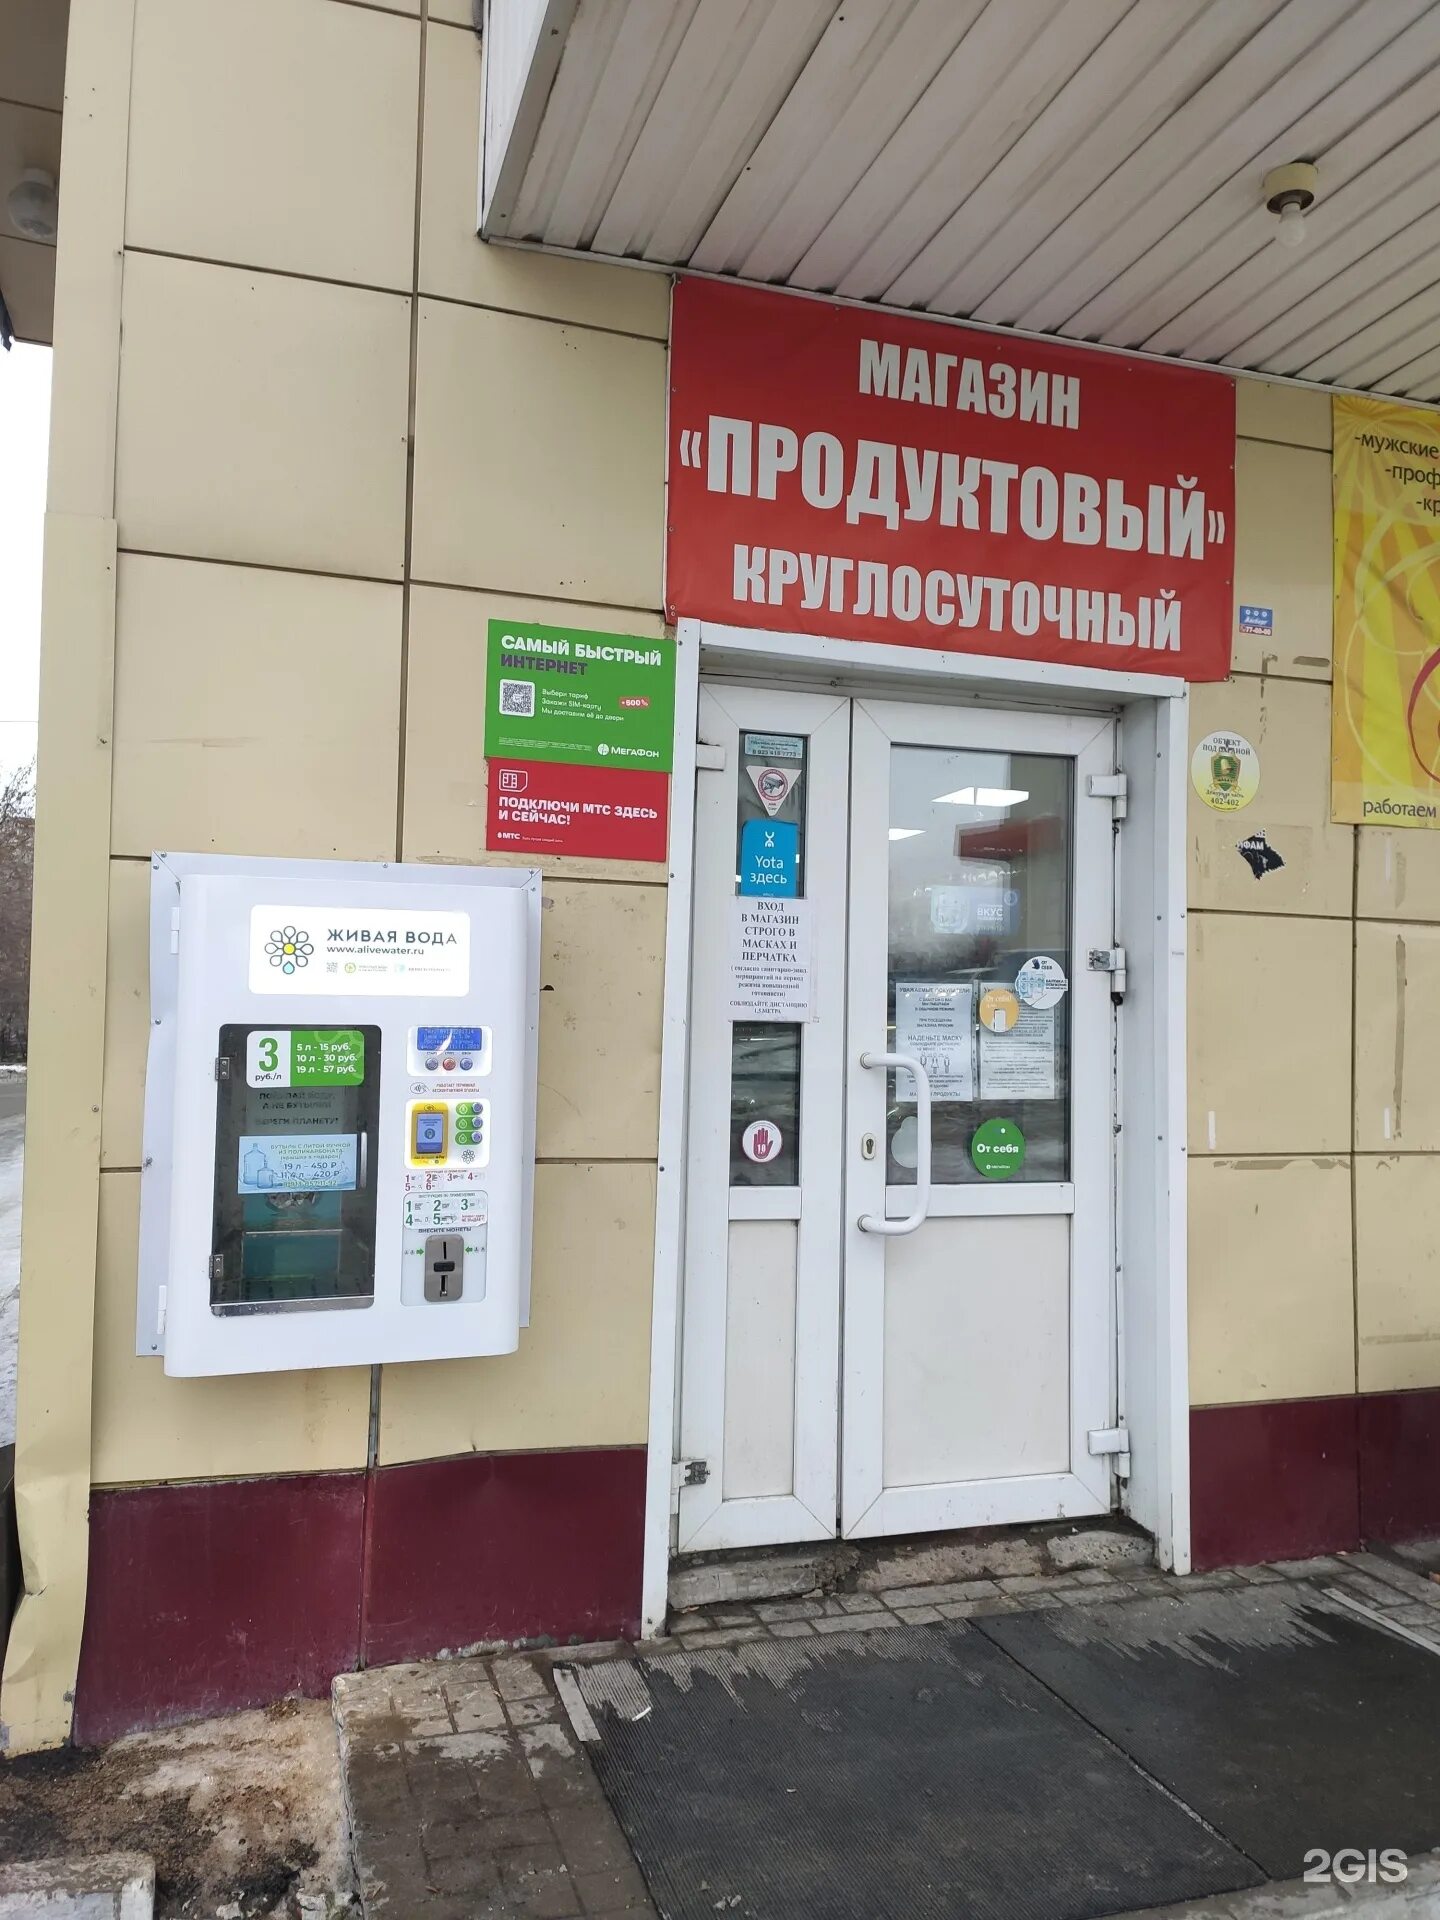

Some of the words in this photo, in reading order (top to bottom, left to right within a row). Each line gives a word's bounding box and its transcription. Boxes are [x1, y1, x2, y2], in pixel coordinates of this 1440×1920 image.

[859, 339, 1080, 430] МАГАЗИН
[1355, 434, 1438, 459] -мужские
[680, 415, 1225, 560] «ПРОДУКТОВЫЙ»
[733, 543, 1181, 651] КРУГЛОСУТОЧНЫЙ
[501, 635, 569, 656] САМЫЙ
[575, 643, 661, 666] БЫСТРЫЙ
[501, 654, 588, 675] ИНТЕРНЕТ
[542, 689, 567, 698] Выбери
[568, 692, 588, 700] тариф
[542, 698, 567, 706] Закажи
[568, 700, 601, 711] SIM-карту
[554, 709, 585, 718] доставим
[1202, 744, 1216, 752] ПОД
[499, 796, 579, 813] ПОДКЛЮЧИ
[583, 803, 611, 816] МТС
[614, 805, 658, 819] ЗДЕСЬ
[1363, 798, 1436, 818] работаем
[499, 810, 508, 820] И
[512, 810, 570, 825] СЕЙЧАС!
[755, 855, 783, 868] Yota
[750, 873, 787, 885] здесь
[758, 902, 784, 912] ВХОД
[977, 908, 1003, 916] ВКУС
[742, 913, 747, 922] В
[751, 914, 799, 924] МАГАЗИН
[745, 927, 786, 936] СТРОГО
[327, 929, 397, 942] ЖИВАЯ
[406, 931, 457, 946] ВОДА
[742, 939, 786, 949] МАСКАХ
[790, 941, 797, 949] И
[326, 946, 424, 955] www.alivewater.ru
[742, 952, 797, 962] ПЕРЧАТКА
[331, 1043, 351, 1052] руб.
[259, 1038, 279, 1072] 3
[296, 1054, 306, 1062] 10
[324, 1054, 335, 1062] 30
[338, 1053, 357, 1063] руб.
[337, 1064, 356, 1074] руб.
[255, 1073, 282, 1082] руб./л
[977, 1144, 990, 1153] От
[993, 1144, 1018, 1153] себя
[427, 1174, 431, 1182] 2
[447, 1173, 452, 1181] 3
[405, 1183, 410, 1191] 5
[406, 1200, 411, 1212] 1
[433, 1200, 441, 1211] 2
[461, 1199, 468, 1210] 3
[406, 1214, 413, 1226] 4
[433, 1213, 440, 1225] 5
